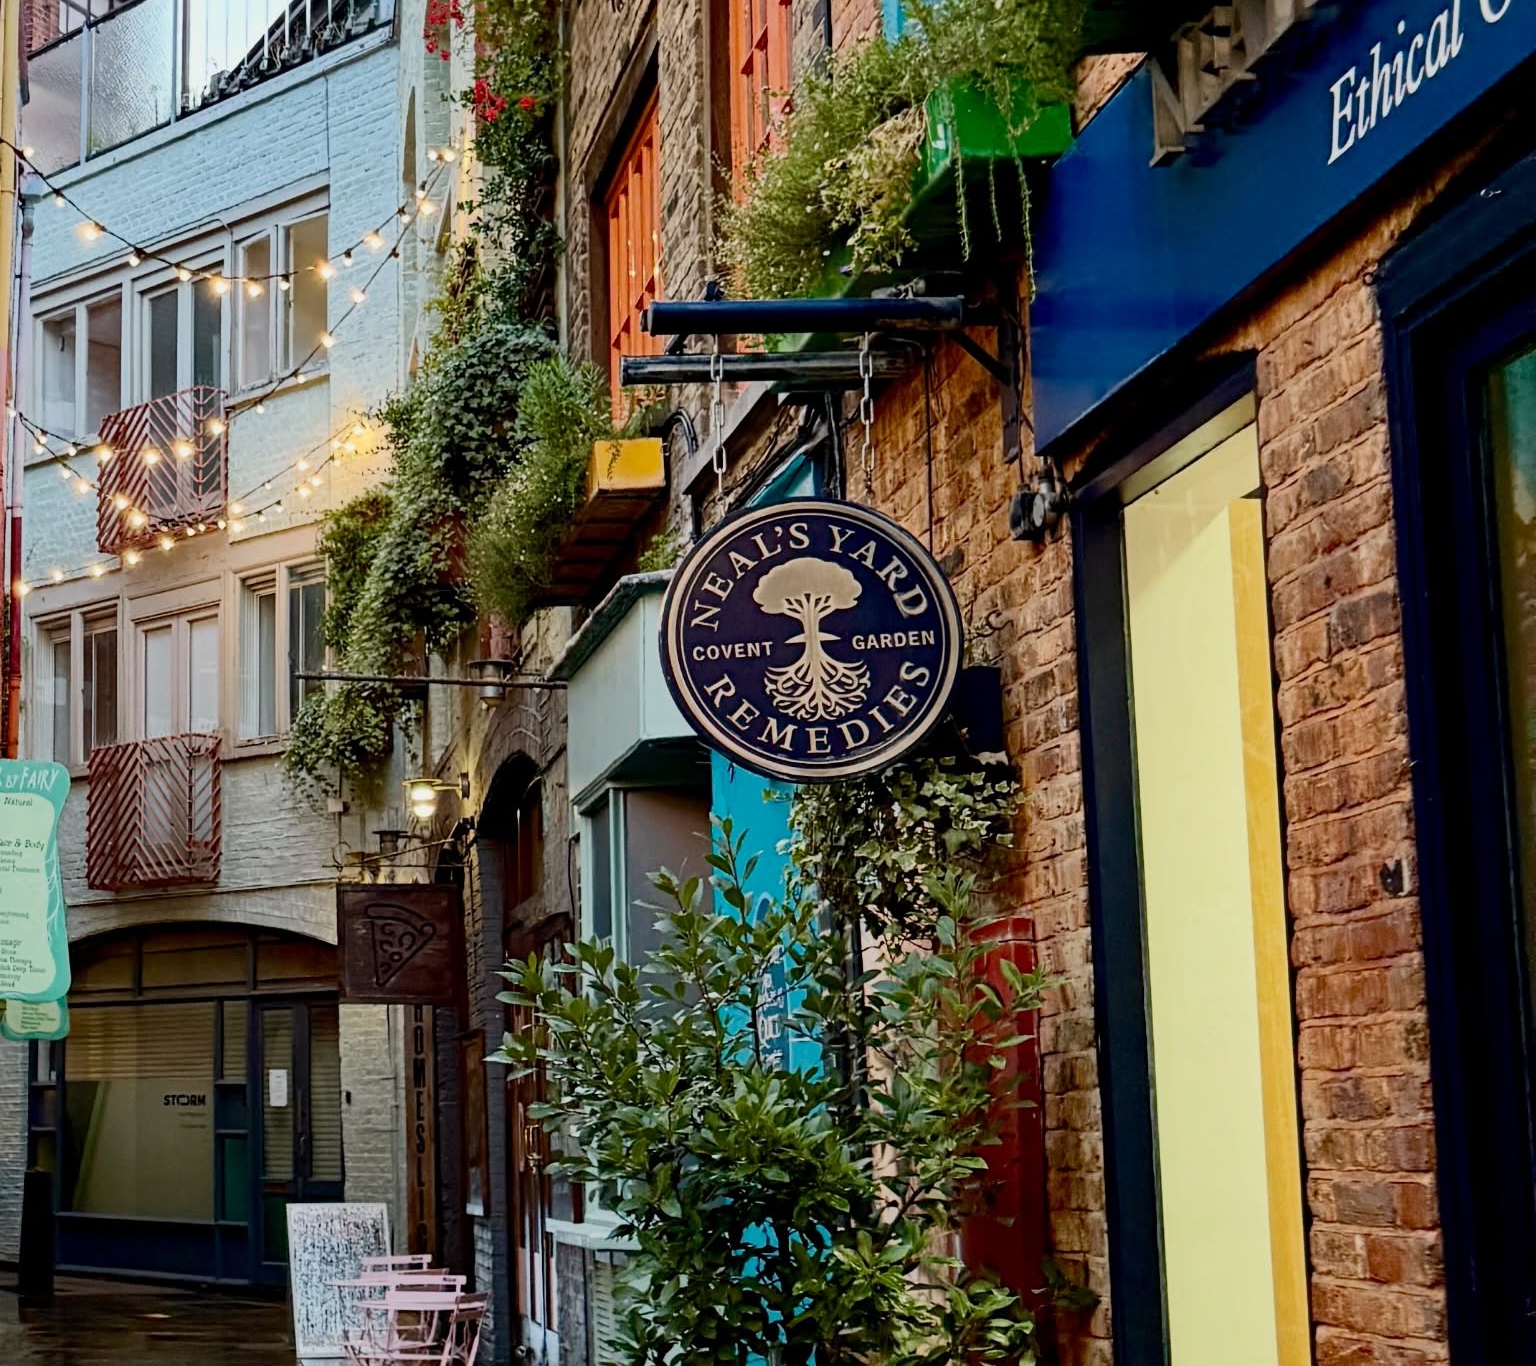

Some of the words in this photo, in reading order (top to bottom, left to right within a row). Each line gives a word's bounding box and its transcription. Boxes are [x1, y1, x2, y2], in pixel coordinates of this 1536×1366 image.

[691, 522, 810, 632] NEAL'S
[827, 524, 928, 619] YARD
[852, 630, 935, 650] GARDEN
[692, 641, 773, 661] COVENT
[704, 661, 931, 754] REMEDIES
[19, 766, 60, 791] FAIRY
[4, 796, 33, 807] Natural
[163, 1094, 206, 1107] STORM
